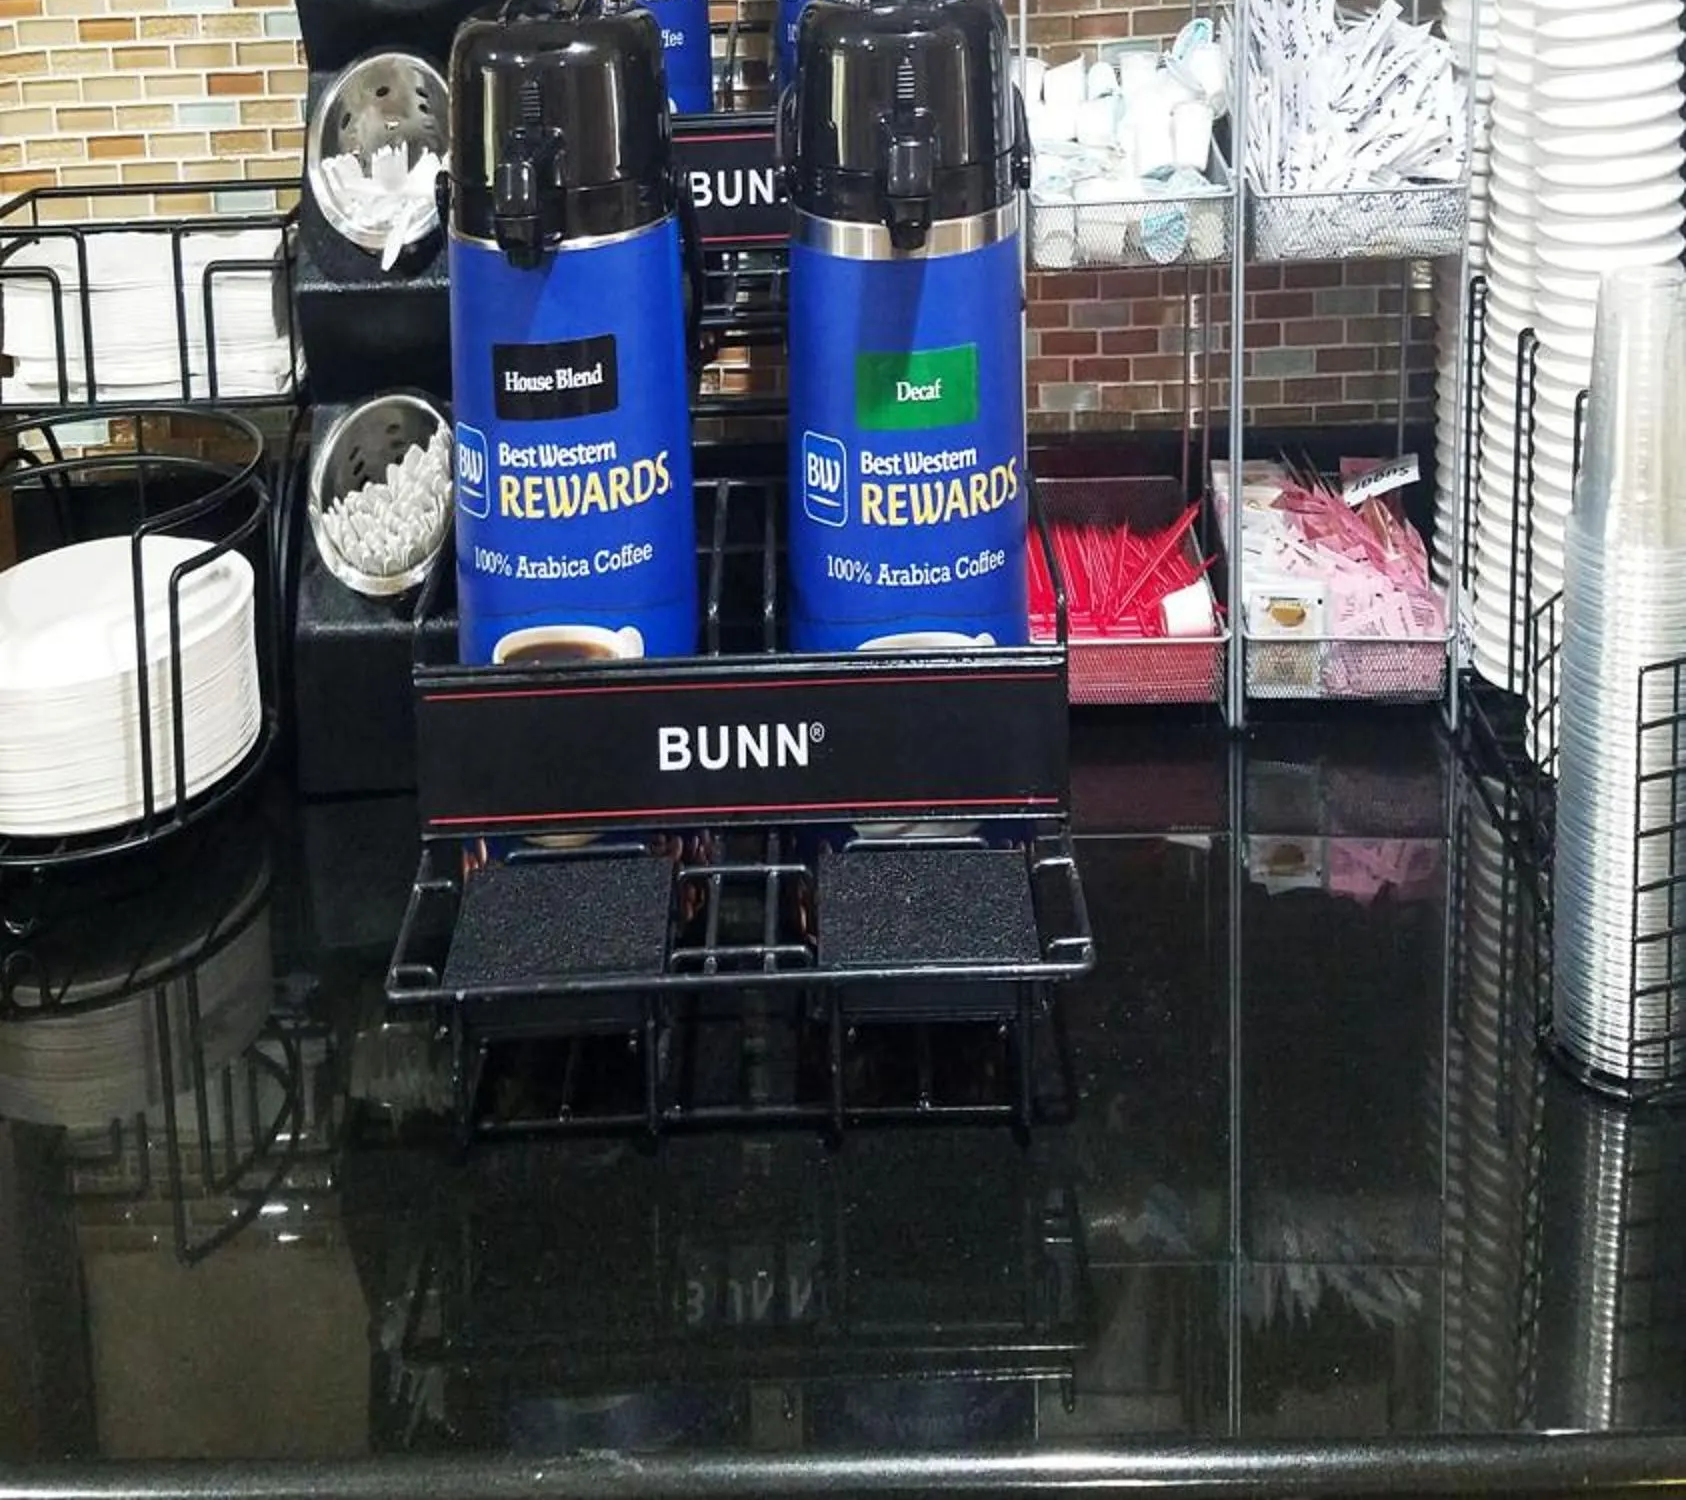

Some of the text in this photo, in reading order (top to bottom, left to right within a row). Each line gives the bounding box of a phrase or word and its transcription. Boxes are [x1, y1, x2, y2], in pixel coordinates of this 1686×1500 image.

[689, 168, 788, 208] BUN
[504, 363, 603, 392] House Blend
[896, 378, 942, 401] Decaf
[459, 443, 483, 484] BW
[498, 440, 617, 468] Best Western
[807, 452, 842, 493] BW
[860, 447, 977, 475] Best Western
[499, 451, 672, 519] REWARDS
[861, 456, 1018, 527] REWARDS
[475, 542, 653, 579] 100% Arabica Coffee
[827, 549, 1005, 587] 100% Arabica Coffee
